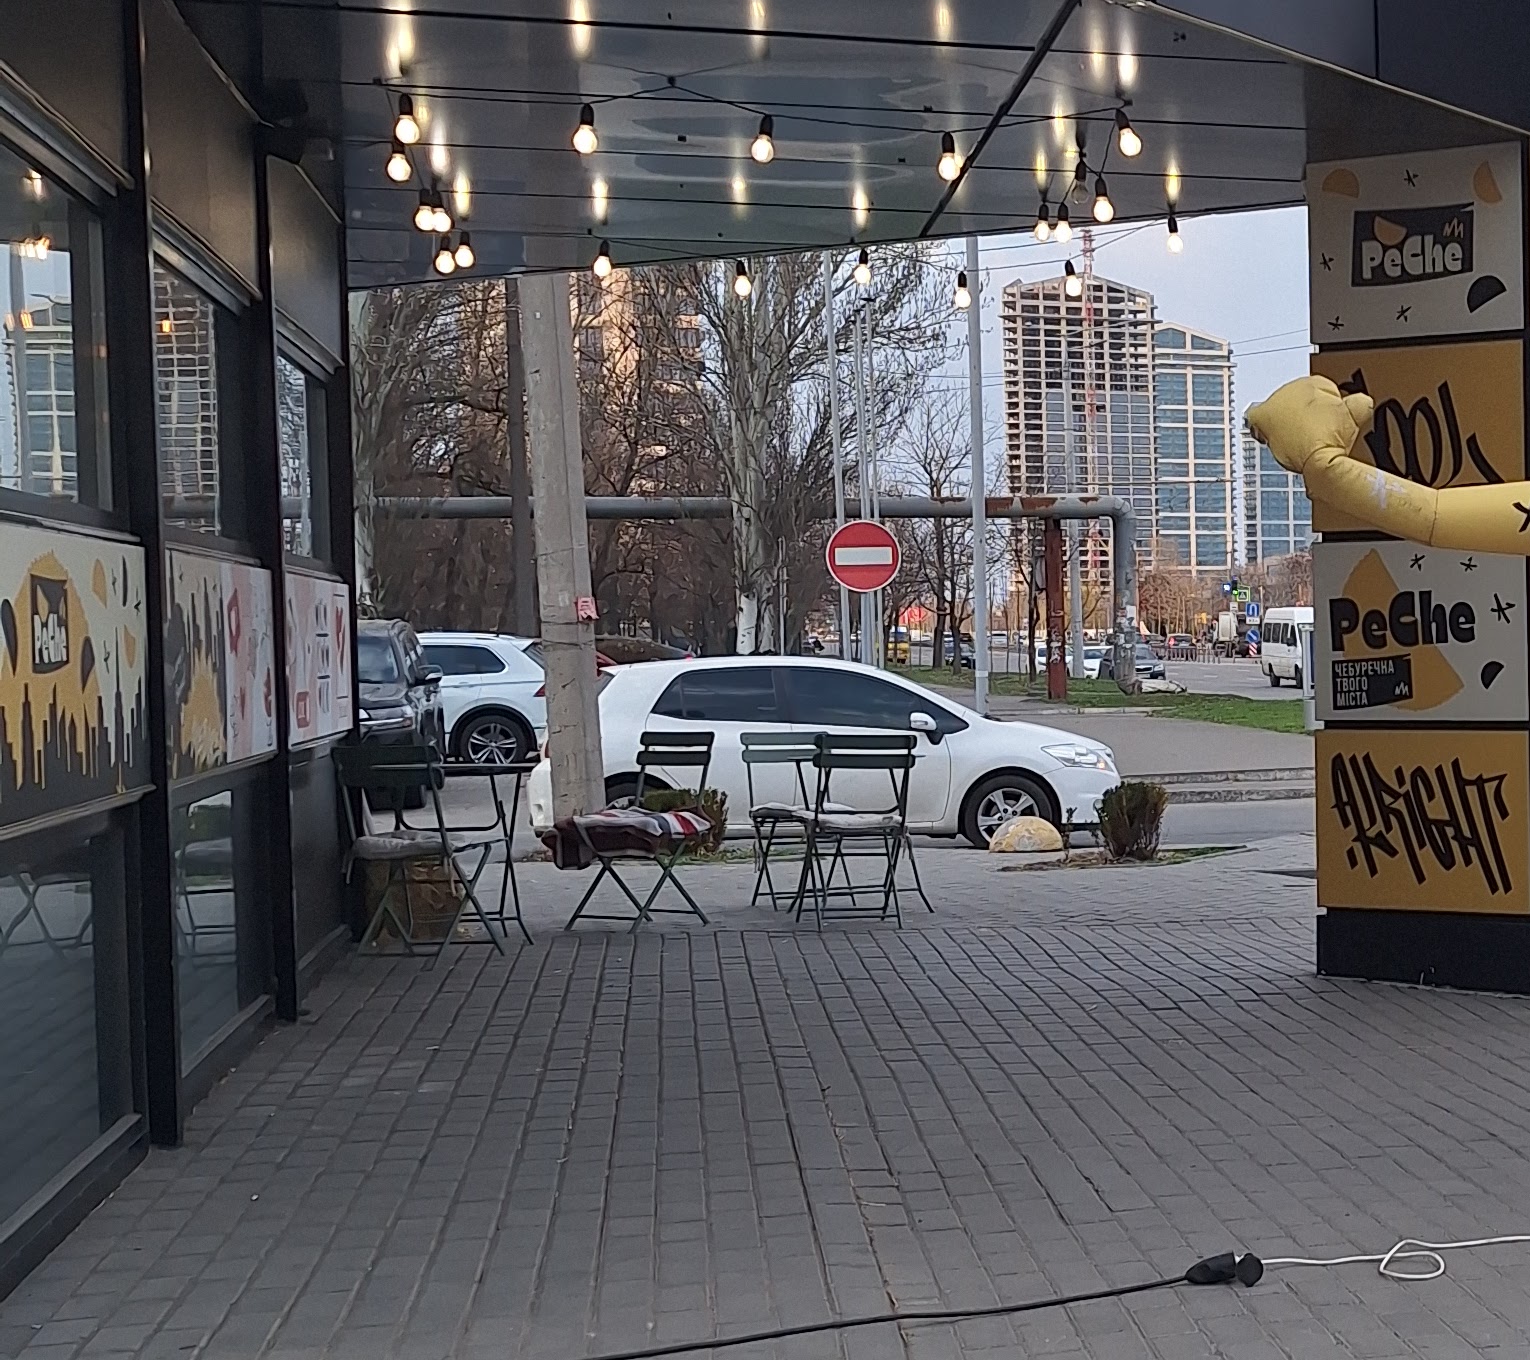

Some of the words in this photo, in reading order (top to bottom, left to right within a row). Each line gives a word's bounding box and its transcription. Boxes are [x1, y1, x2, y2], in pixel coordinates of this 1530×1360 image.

[1338, 368, 1506, 490] OOL
[1335, 660, 1395, 677] ЧЕБУРЕЧНА
[1336, 677, 1368, 691] ТВОГО
[1336, 692, 1368, 707] МІСТА
